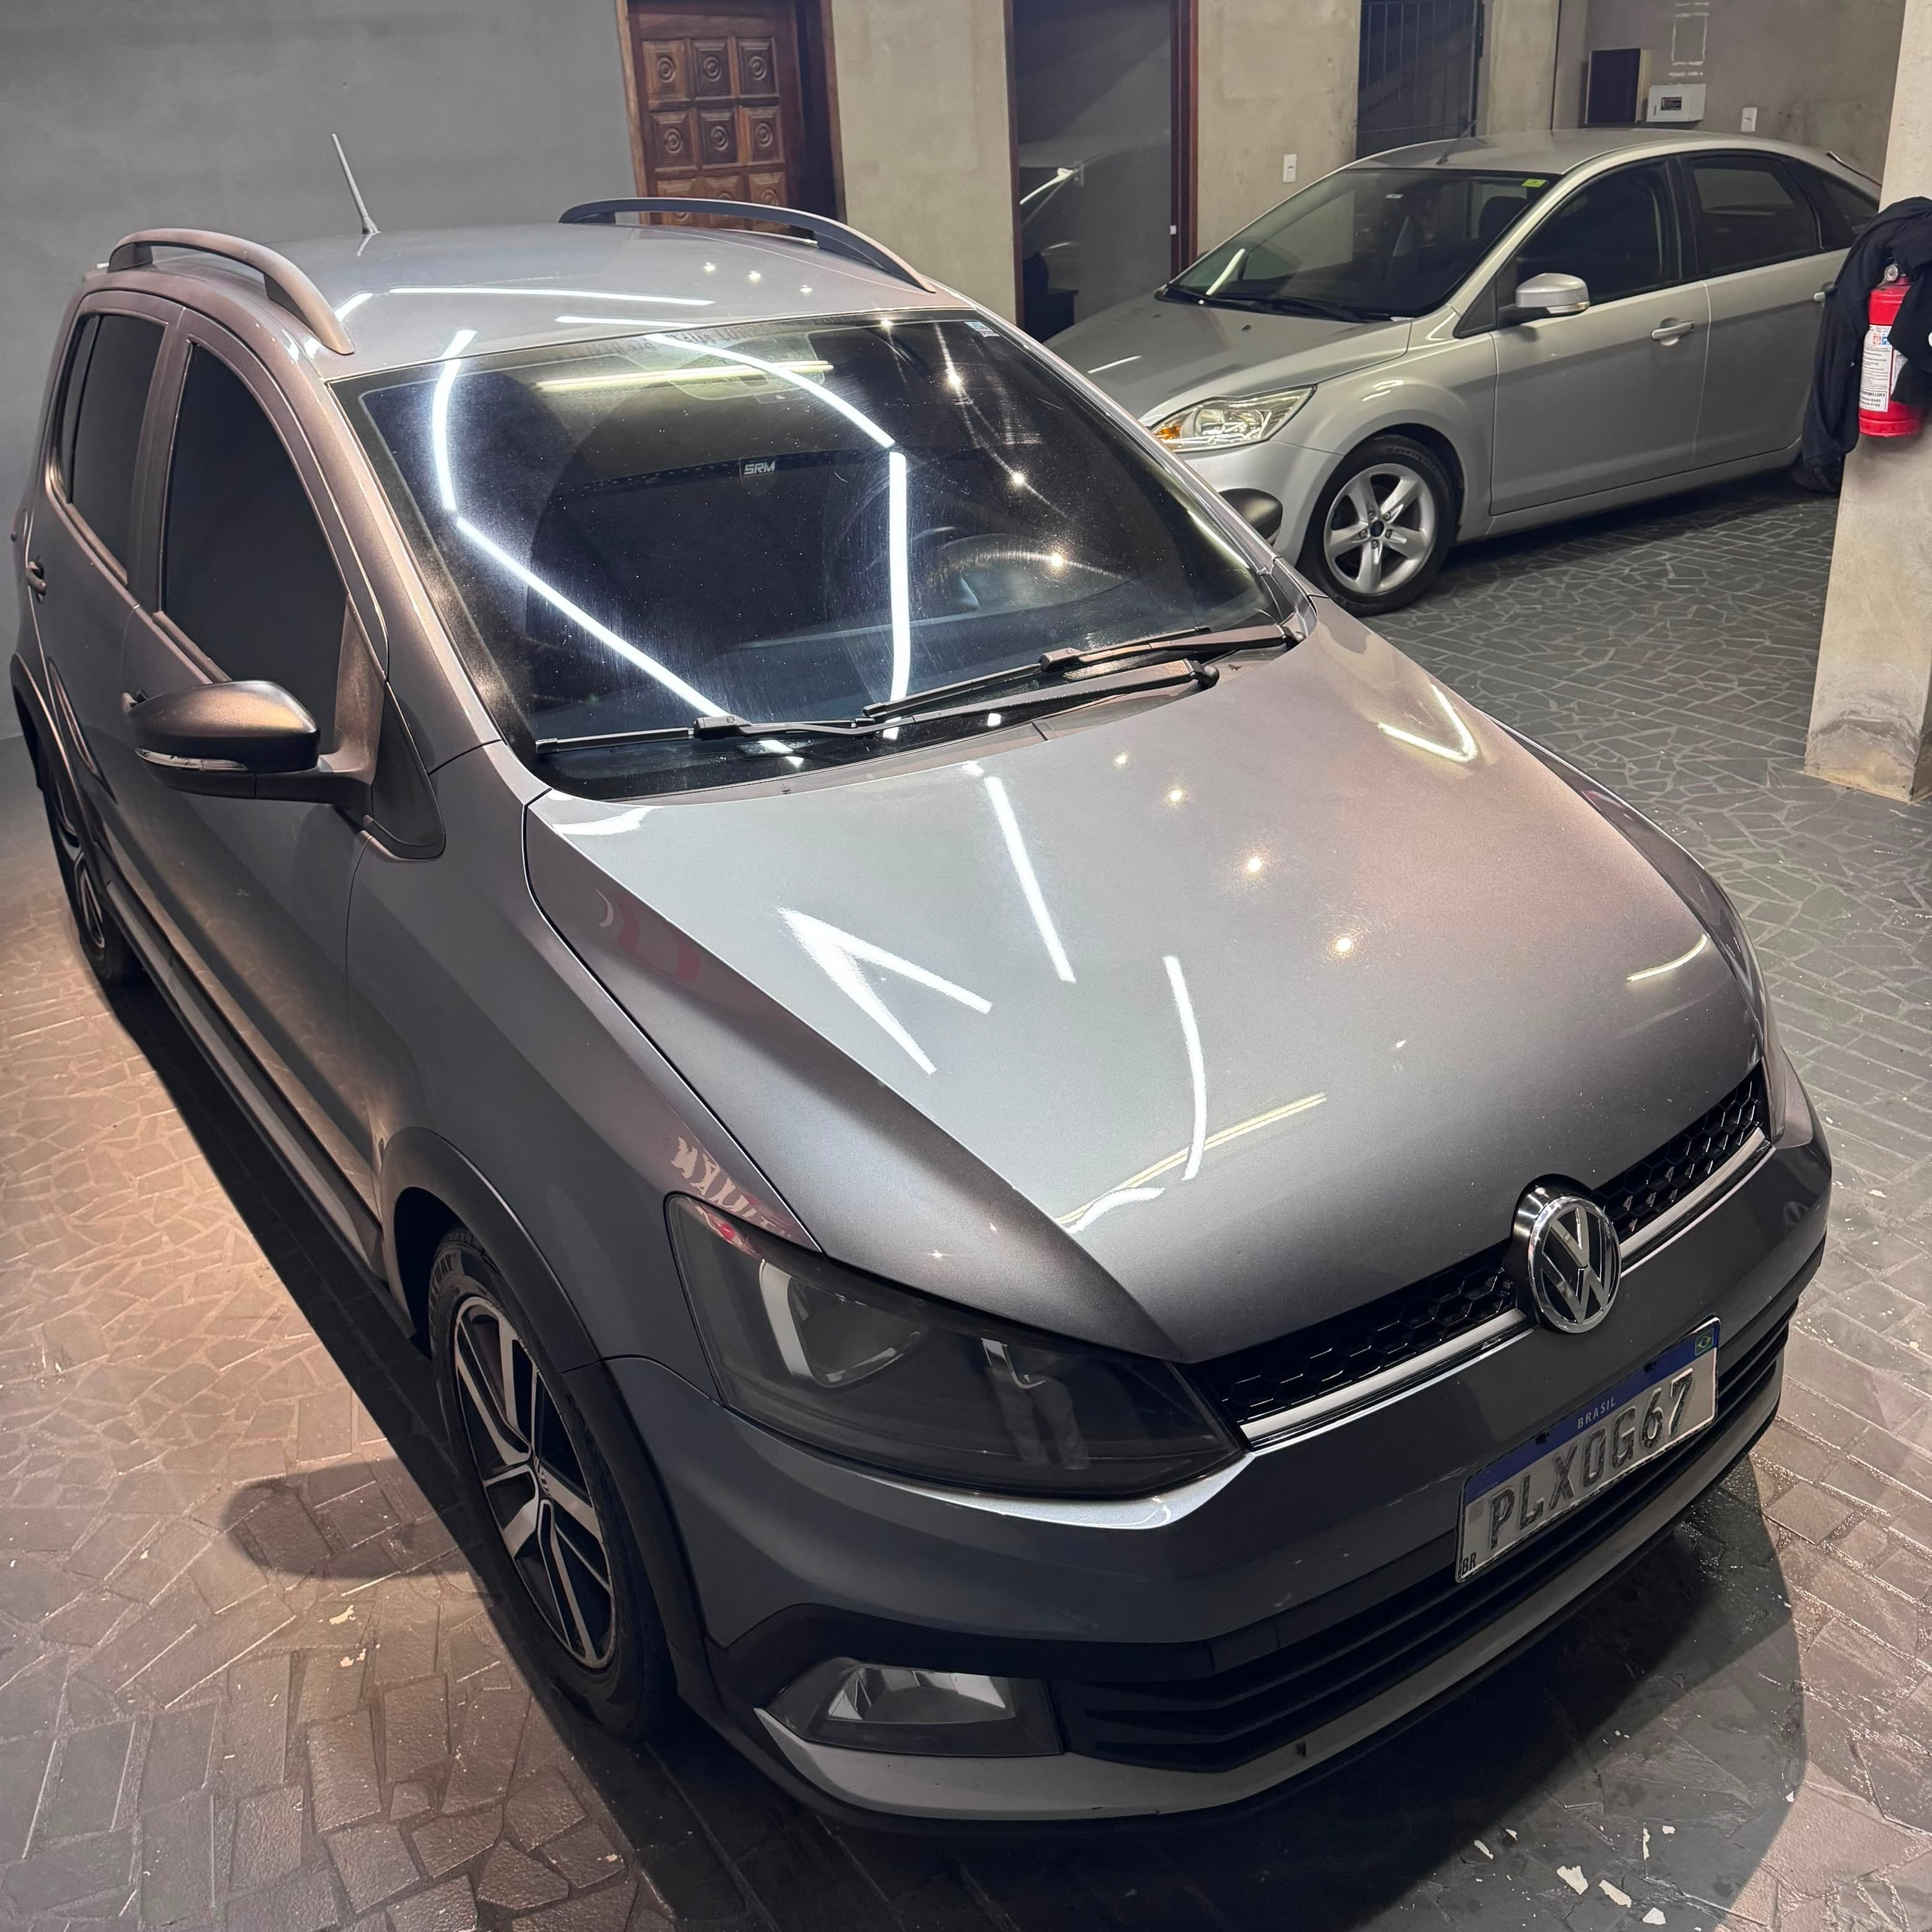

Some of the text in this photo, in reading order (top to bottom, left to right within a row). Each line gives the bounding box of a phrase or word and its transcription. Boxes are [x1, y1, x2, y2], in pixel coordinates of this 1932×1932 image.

[743, 461, 775, 475] SRM
[1577, 1396, 1617, 1429] BRASIL
[1461, 1552, 1477, 1573] BR
